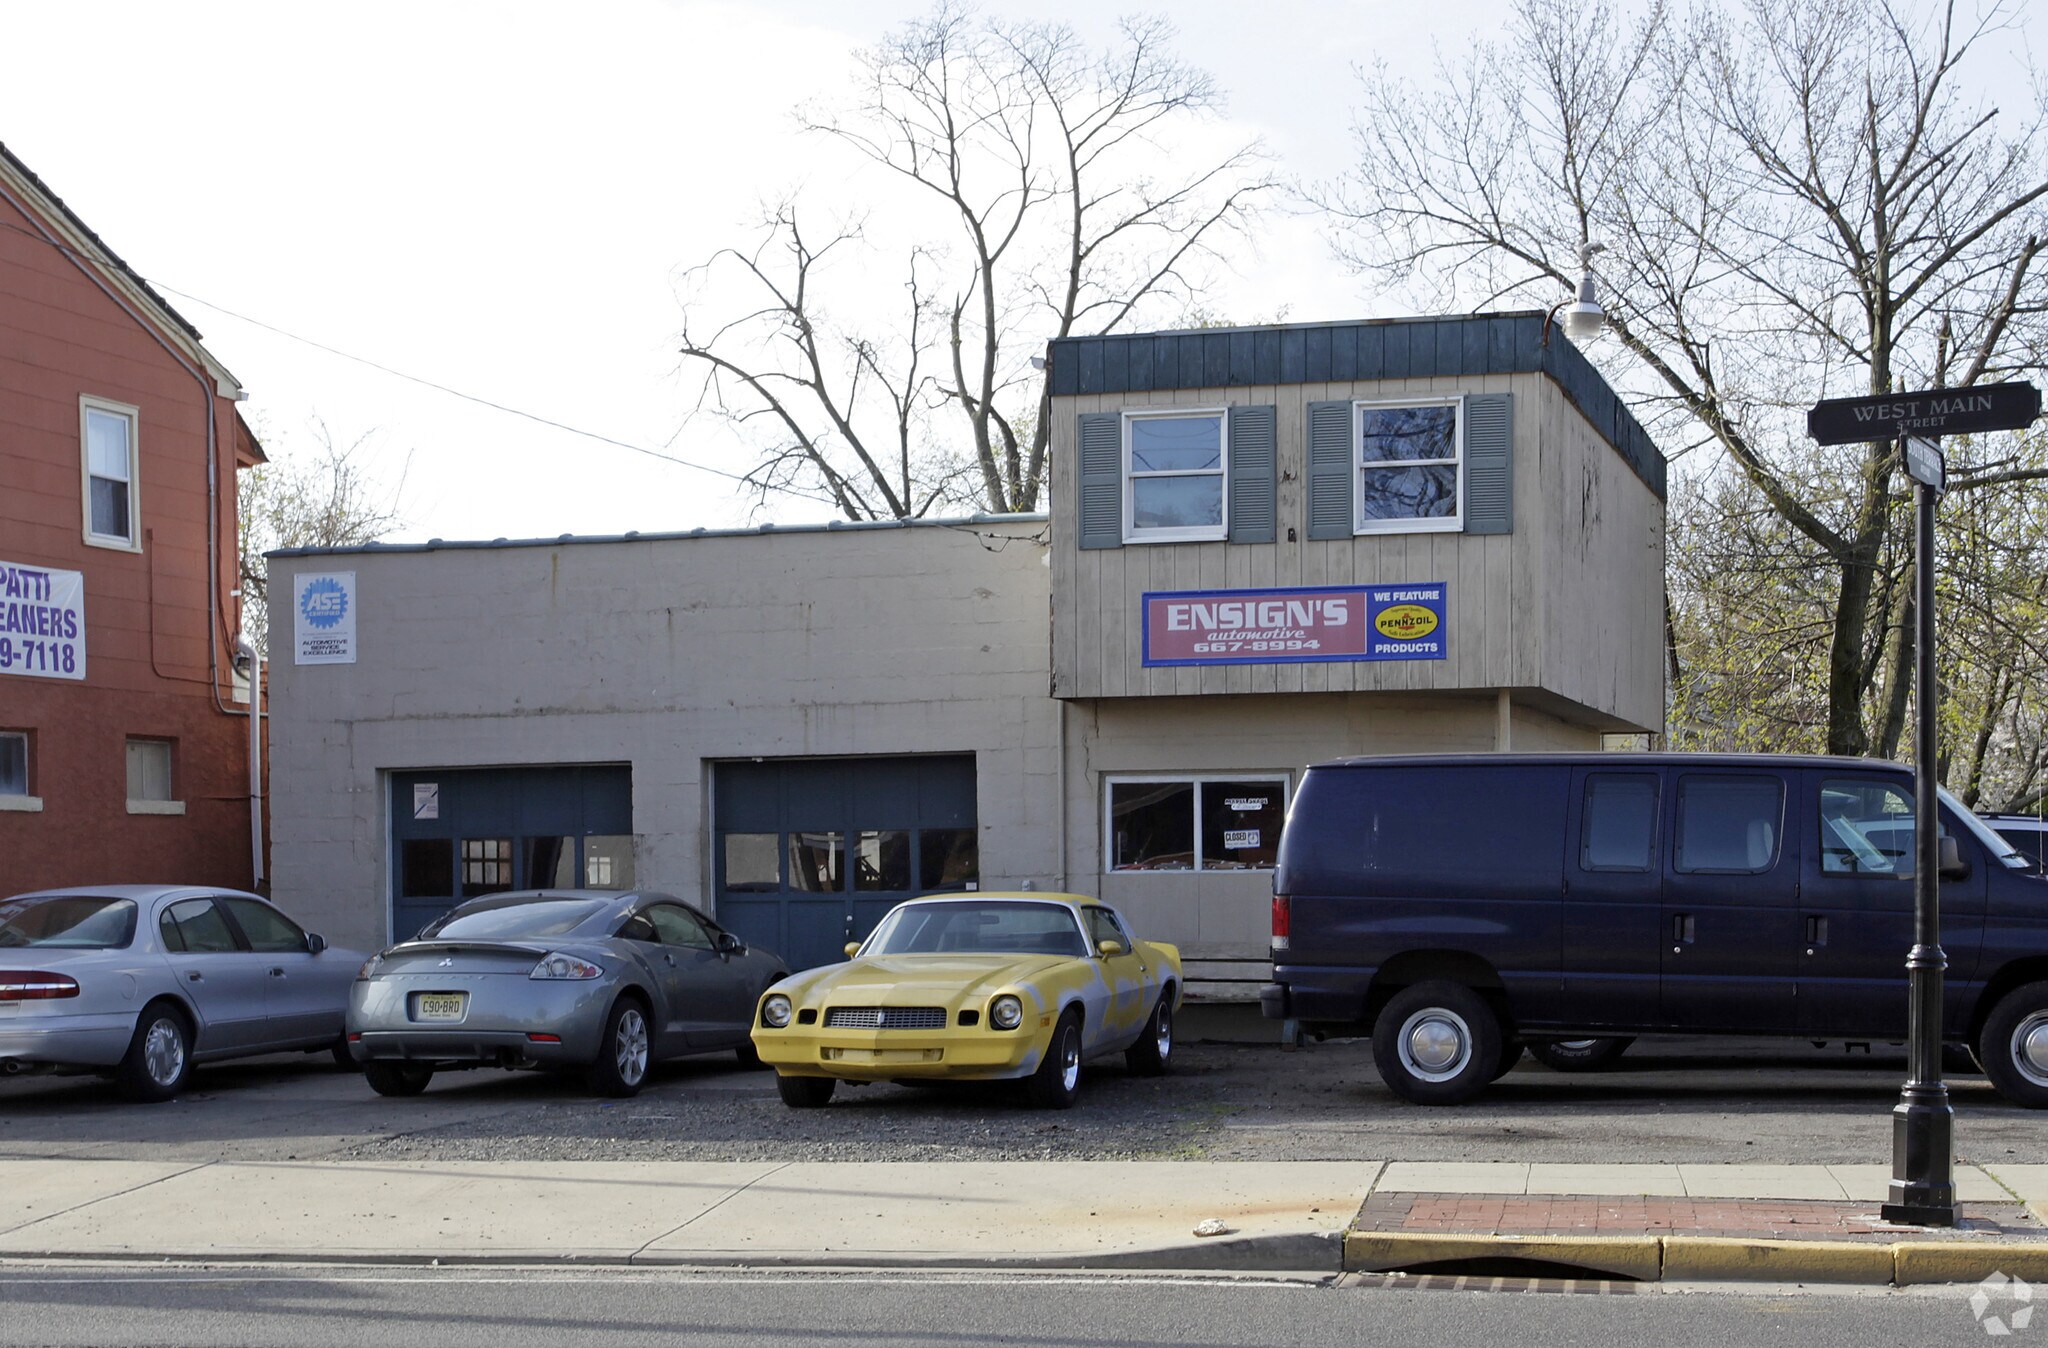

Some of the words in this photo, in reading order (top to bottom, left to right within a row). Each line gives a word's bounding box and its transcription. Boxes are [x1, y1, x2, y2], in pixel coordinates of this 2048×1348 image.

[1852, 401, 1920, 422] WEST
[1929, 395, 1992, 415] MAIN
[1896, 416, 1947, 430] STREET
[307, 592, 341, 611] ASE
[1374, 592, 1390, 602] WE
[1393, 590, 1440, 601] FEATURE
[1167, 599, 1348, 631] ENSIGN'S
[1380, 616, 1433, 629] PENNZOIL
[1207, 627, 1306, 641] automotive
[1193, 640, 1321, 653] 667-8994
[1375, 643, 1438, 654] PRODUCTS
[0, 637, 76, 674] 9-7118
[1225, 832, 1246, 841] CLOSED
